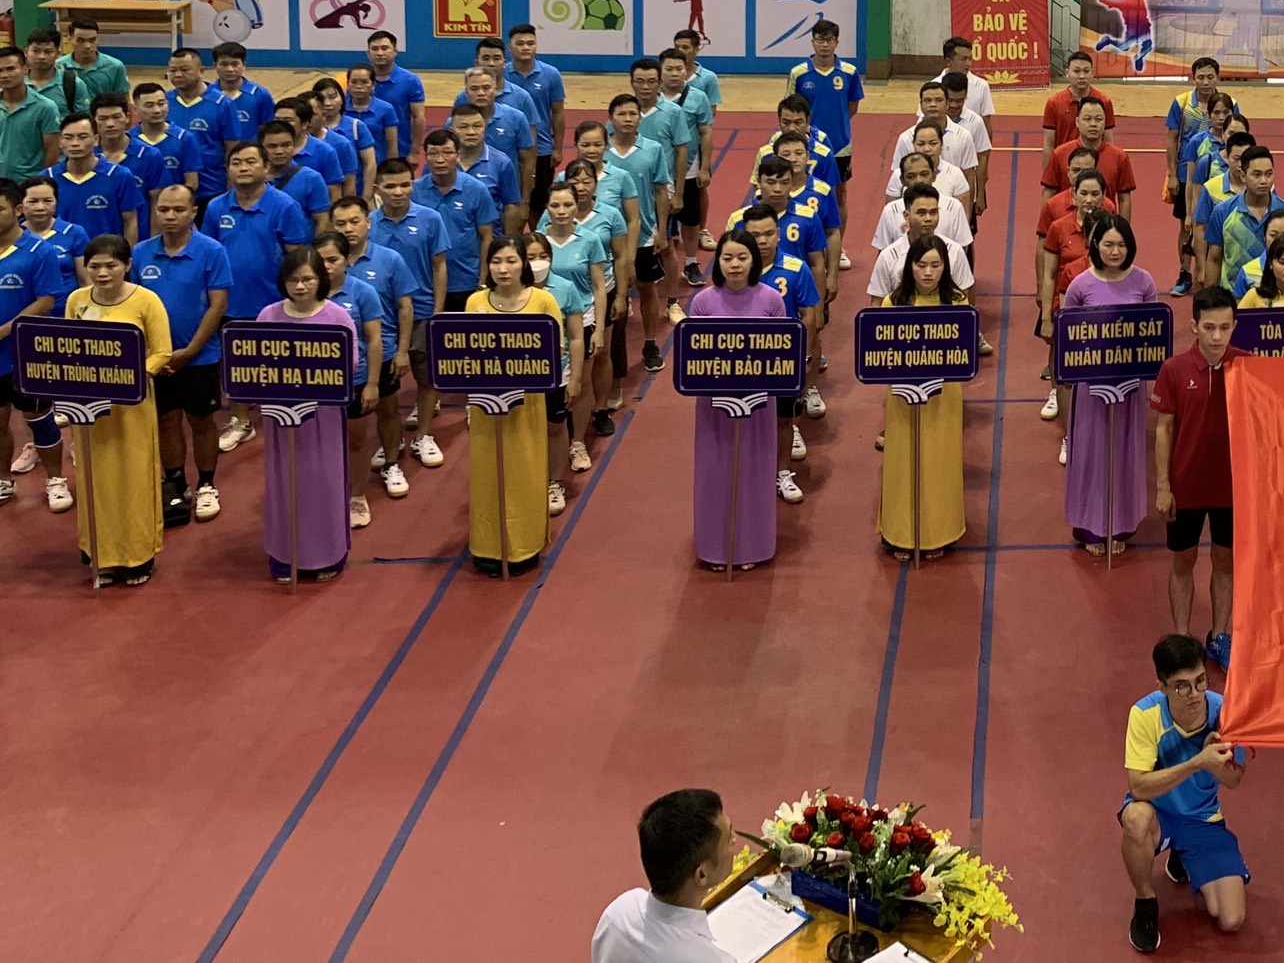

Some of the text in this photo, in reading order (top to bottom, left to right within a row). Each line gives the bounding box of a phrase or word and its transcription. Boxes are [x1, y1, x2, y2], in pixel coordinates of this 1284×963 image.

[444, 23, 468, 32] KIM
[973, 6, 1028, 35] BẢO VỆ
[986, 35, 1028, 63] QUỐC
[832, 75, 844, 90] 9
[786, 222, 800, 242] 6
[774, 277, 788, 297] 3
[875, 323, 959, 343] CHI CỤC THADS
[1067, 315, 1164, 344] VIỆN KIỂM SÁT
[1259, 320, 1282, 340] TÒA
[34, 336, 122, 357] CHI CỤC THADS
[232, 339, 341, 361] CHI CỤC THADS
[444, 333, 542, 352] CHI CỤC THADS
[690, 333, 792, 353] CHI CỤC THADS
[865, 345, 970, 369] HUYỆN QUẢNG HÒA
[1064, 341, 1166, 367] NHÂN DÂN TỈNH
[26, 360, 135, 385] HUYỆN TRÙNG KHÁNH
[231, 364, 344, 388] HUYỆN HẠ LANG
[438, 354, 551, 378] HUYỆN HÀ QUẢNG
[687, 354, 795, 379] HUYỆN BẢO LÂM
